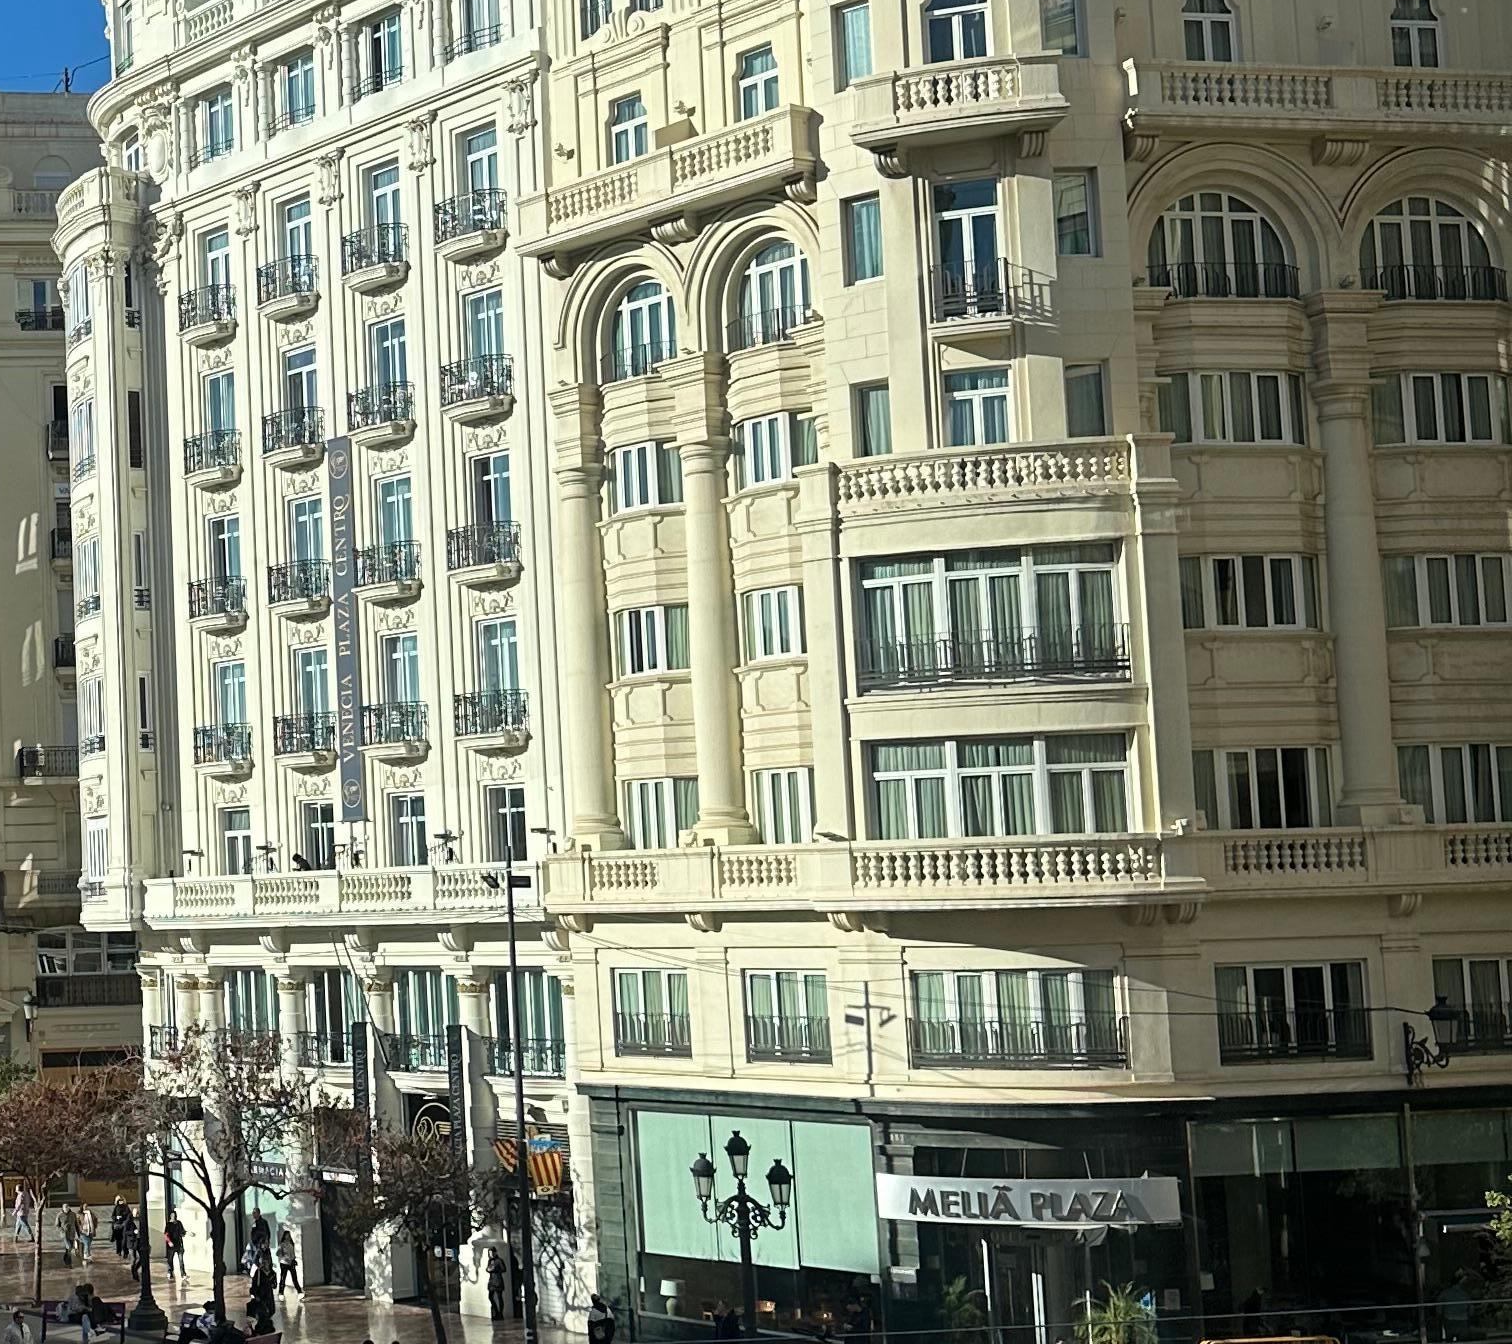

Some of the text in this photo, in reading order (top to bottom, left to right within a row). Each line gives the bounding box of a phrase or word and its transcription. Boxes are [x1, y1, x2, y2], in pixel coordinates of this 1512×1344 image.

[332, 493, 353, 764] VENECIA PLAZA CENTRO
[1029, 1189, 1140, 1222] PLAZA
